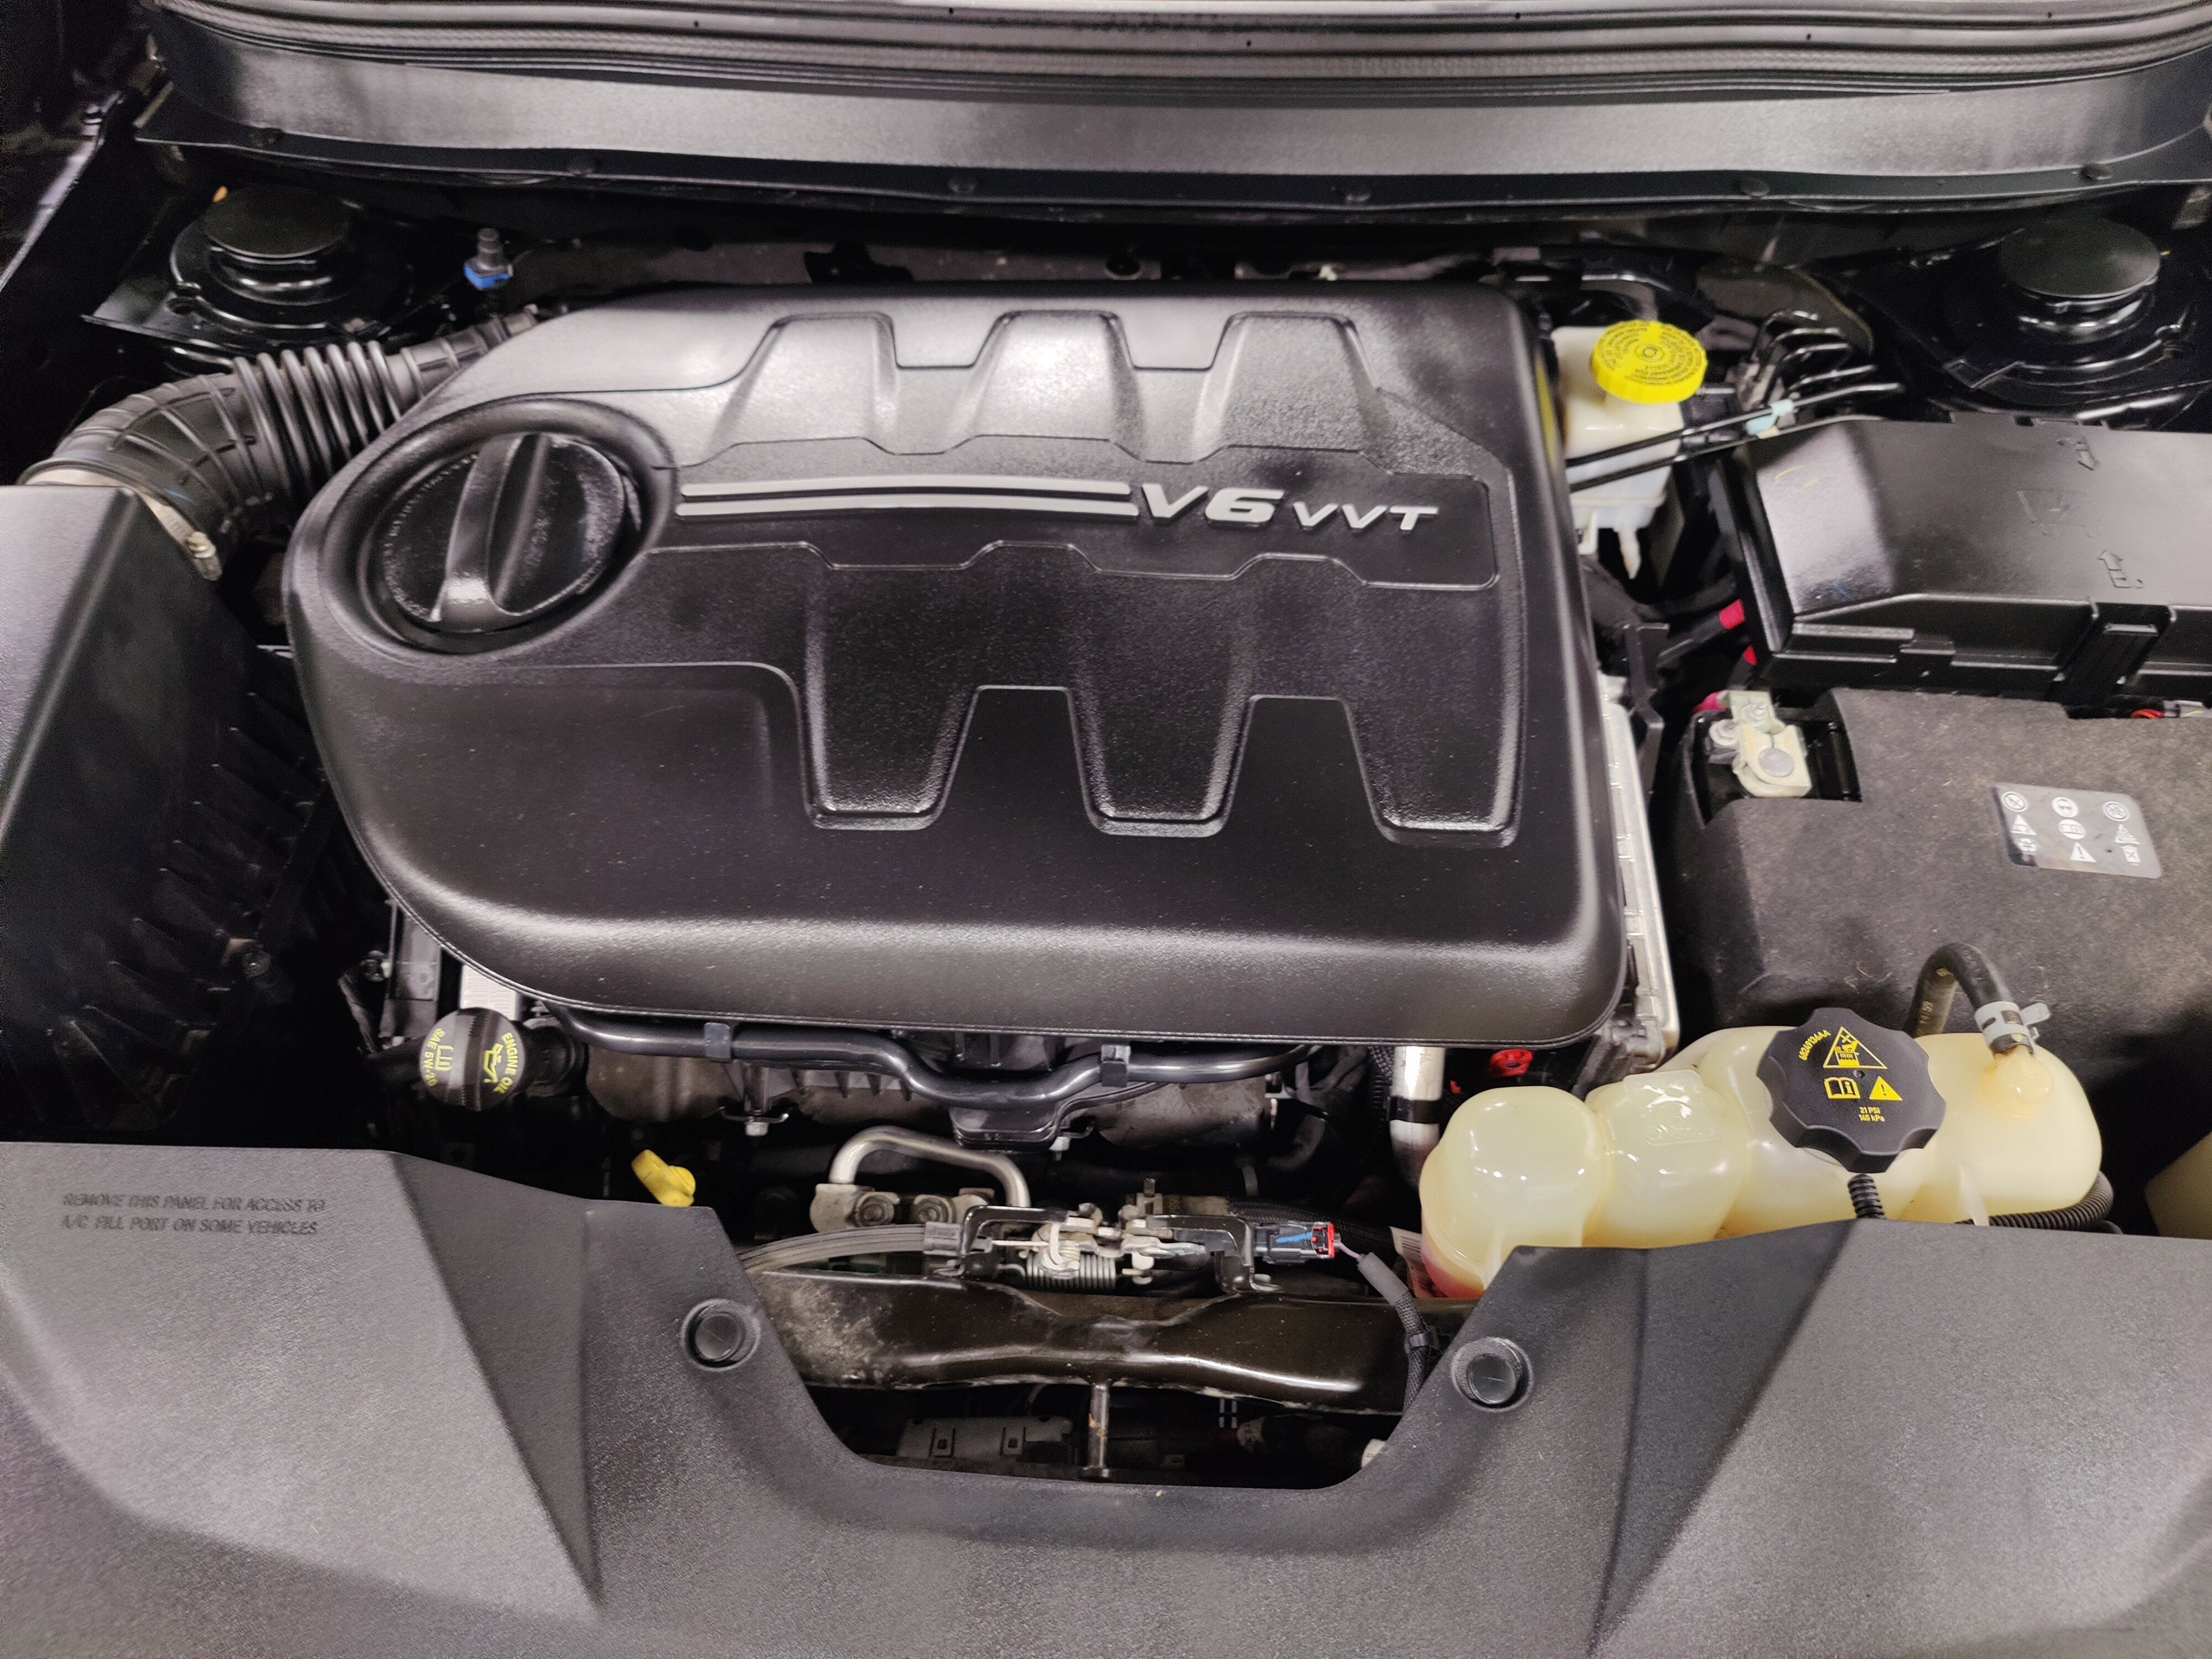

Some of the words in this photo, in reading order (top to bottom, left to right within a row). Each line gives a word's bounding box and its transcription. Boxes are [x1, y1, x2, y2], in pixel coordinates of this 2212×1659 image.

[1142, 483, 1285, 524] V6
[1292, 502, 1439, 531] VVT
[426, 1027, 446, 1050] SAE
[501, 1032, 518, 1076] ENGINE
[423, 1051, 438, 1087] 5W-20
[493, 1077, 514, 1094] OIL
[1868, 1107, 1881, 1115] PSI
[1870, 1114, 1885, 1123] kPa
[62, 1192, 124, 1207] REMOVE
[129, 1193, 160, 1208] THIS
[163, 1194, 207, 1210] PANEL
[212, 1196, 243, 1211] FOR
[246, 1197, 302, 1212] ACCESS
[306, 1198, 326, 1213] TO
[61, 1214, 88, 1230] A/C
[95, 1215, 124, 1230] FILL
[130, 1216, 169, 1232] PORT
[173, 1218, 198, 1232] ON
[200, 1218, 243, 1234] SOME
[247, 1219, 319, 1235] VEHICLES
